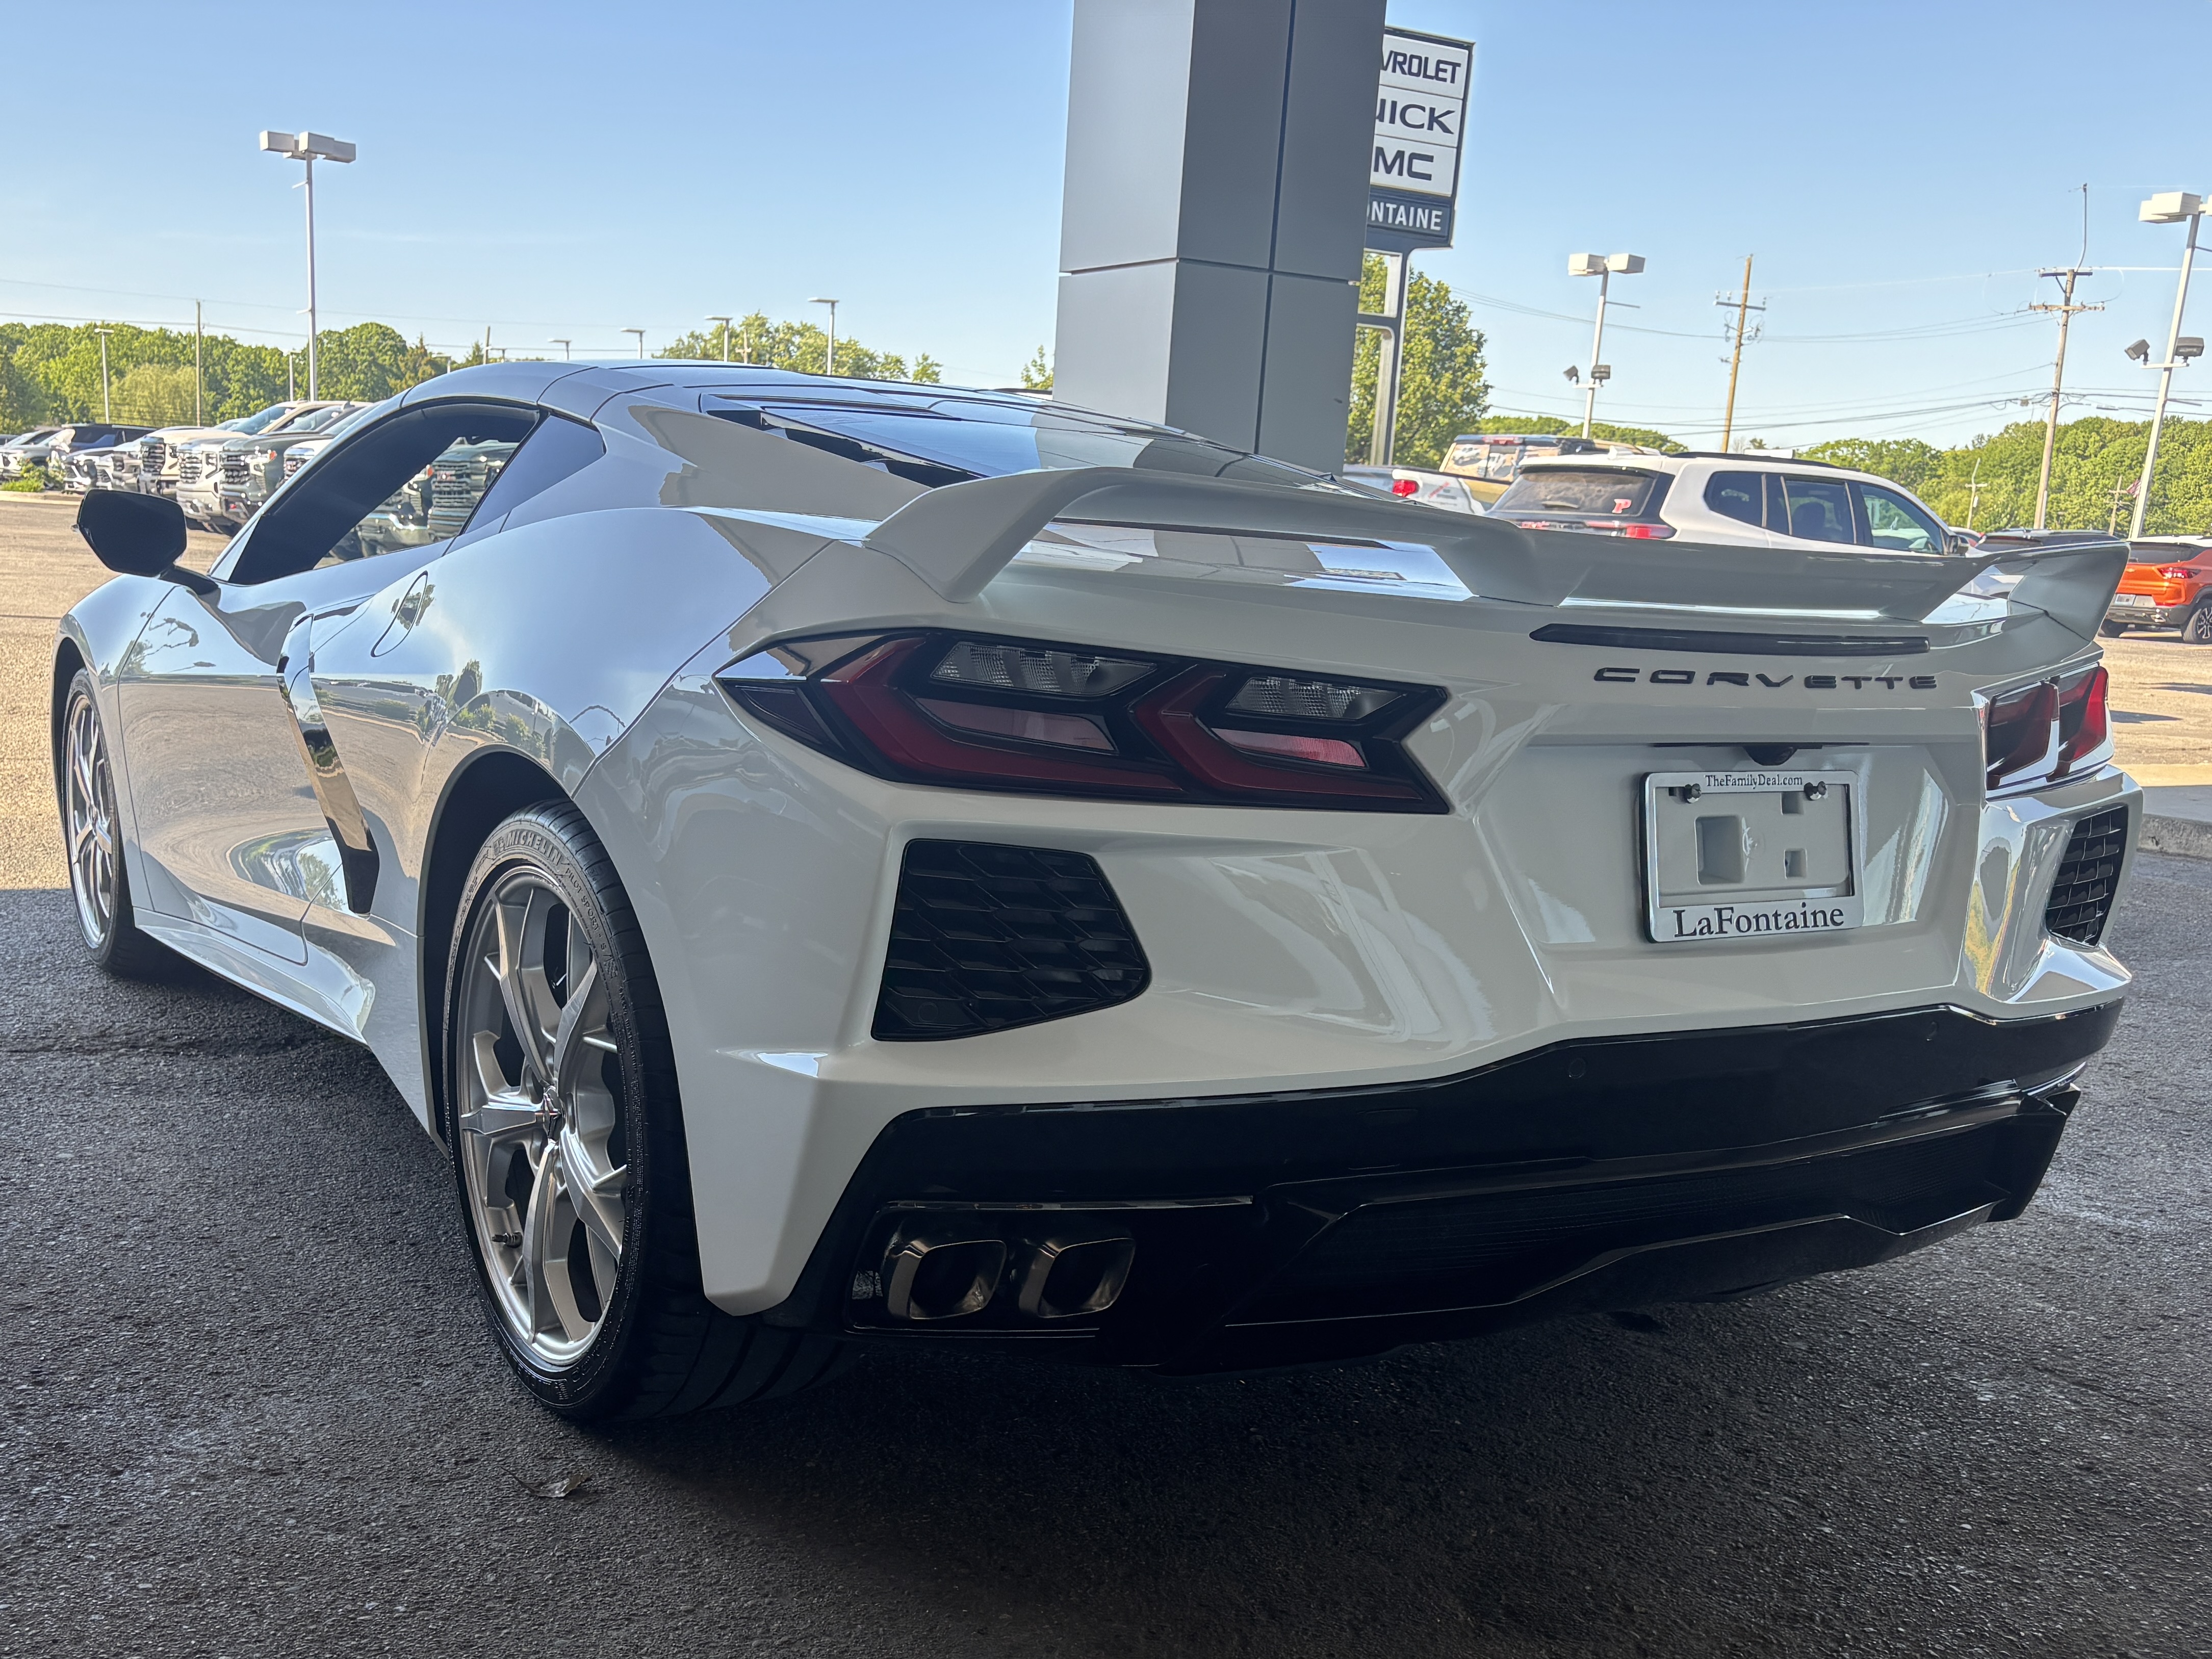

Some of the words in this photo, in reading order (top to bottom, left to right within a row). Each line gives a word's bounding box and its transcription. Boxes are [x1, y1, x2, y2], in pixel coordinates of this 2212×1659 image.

[1373, 146, 1434, 181] MC
[1367, 201, 1443, 230] NTAINE
[1594, 667, 1937, 689] CORVETTE
[1705, 774, 1803, 789] TheFamilyDeal.com
[506, 830, 562, 866] MICHELIN
[565, 868, 583, 893] PILOT
[581, 896, 599, 931] SPORT
[1673, 902, 1844, 937] LaFontaine
